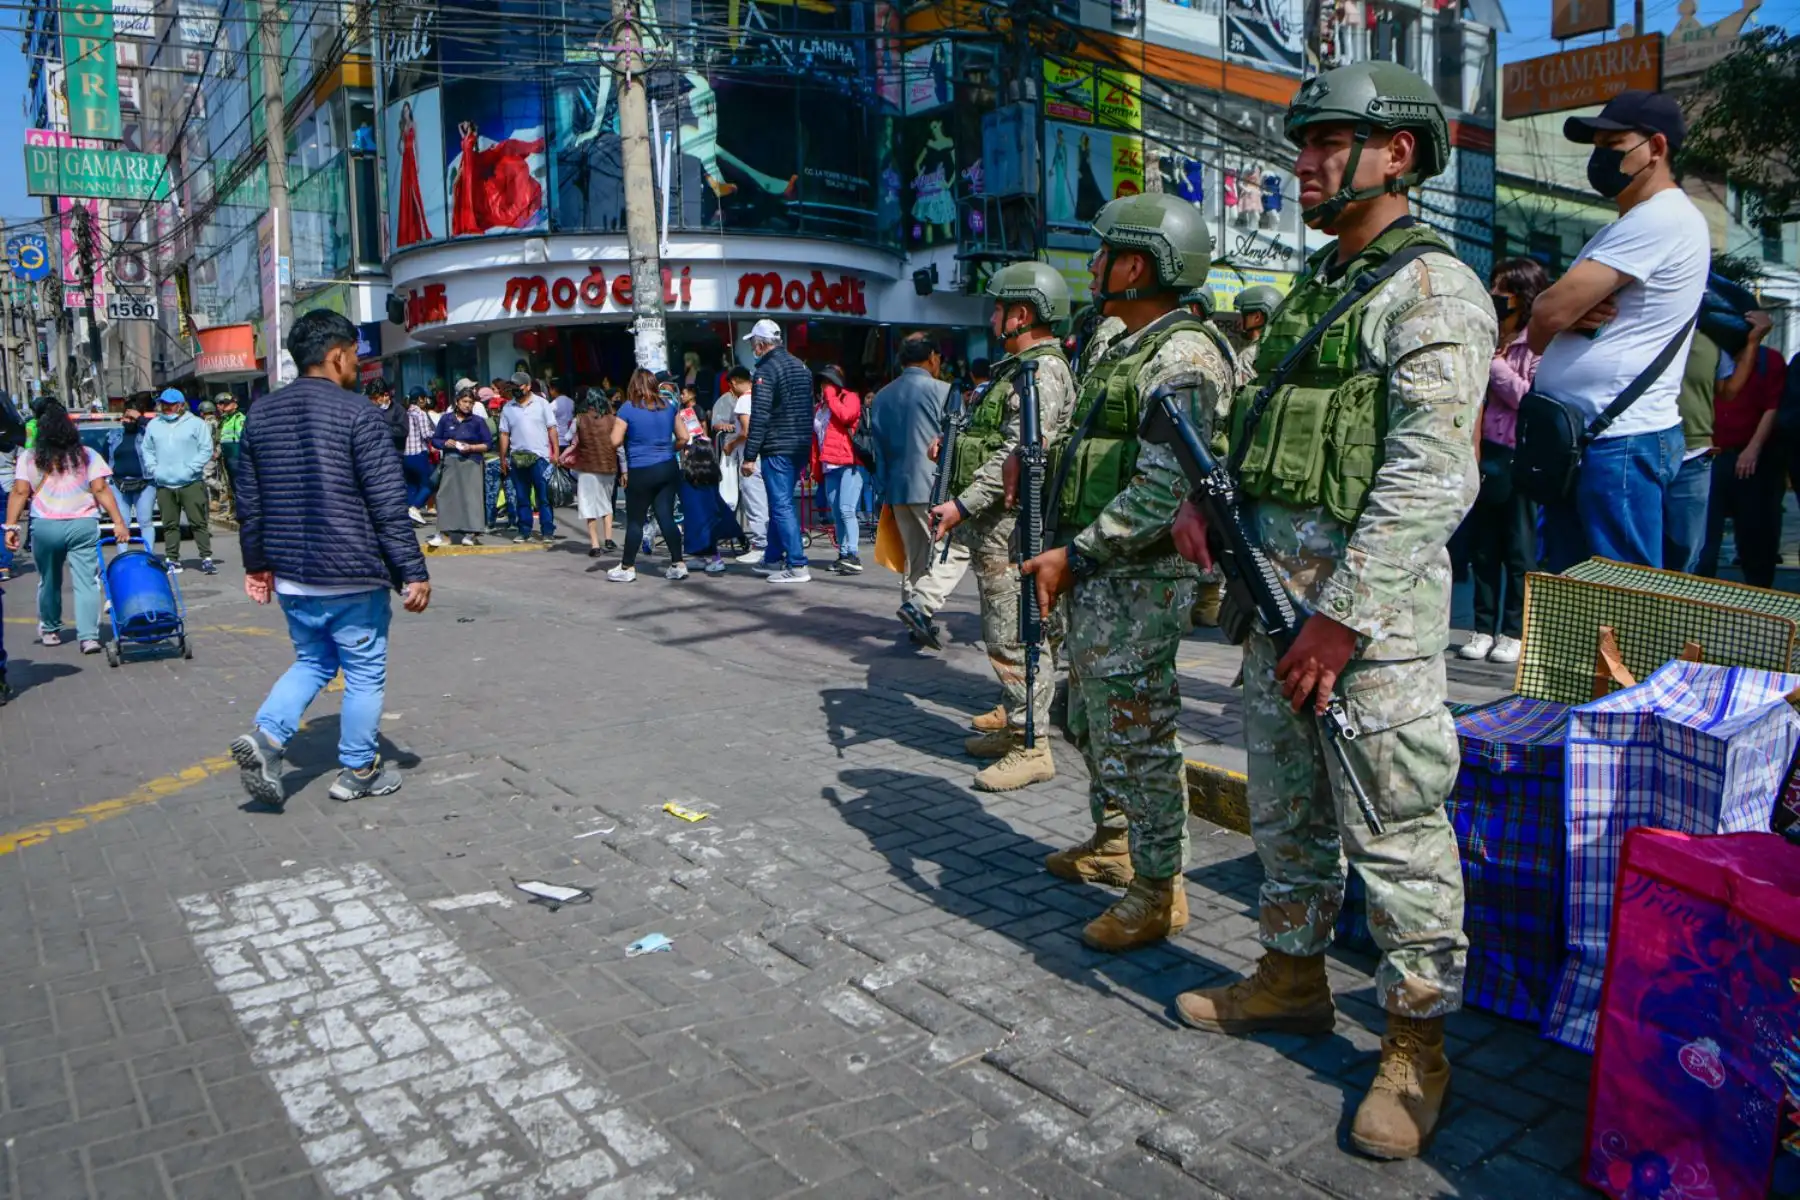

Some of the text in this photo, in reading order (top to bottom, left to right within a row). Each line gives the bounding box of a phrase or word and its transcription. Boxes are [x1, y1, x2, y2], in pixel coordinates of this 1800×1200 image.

[1510, 64, 1535, 93] DE
[1540, 44, 1652, 87] GAMARRA
[33, 150, 165, 182] DE GAMARRA
[110, 303, 155, 316] 1560
[503, 266, 692, 314] modeli
